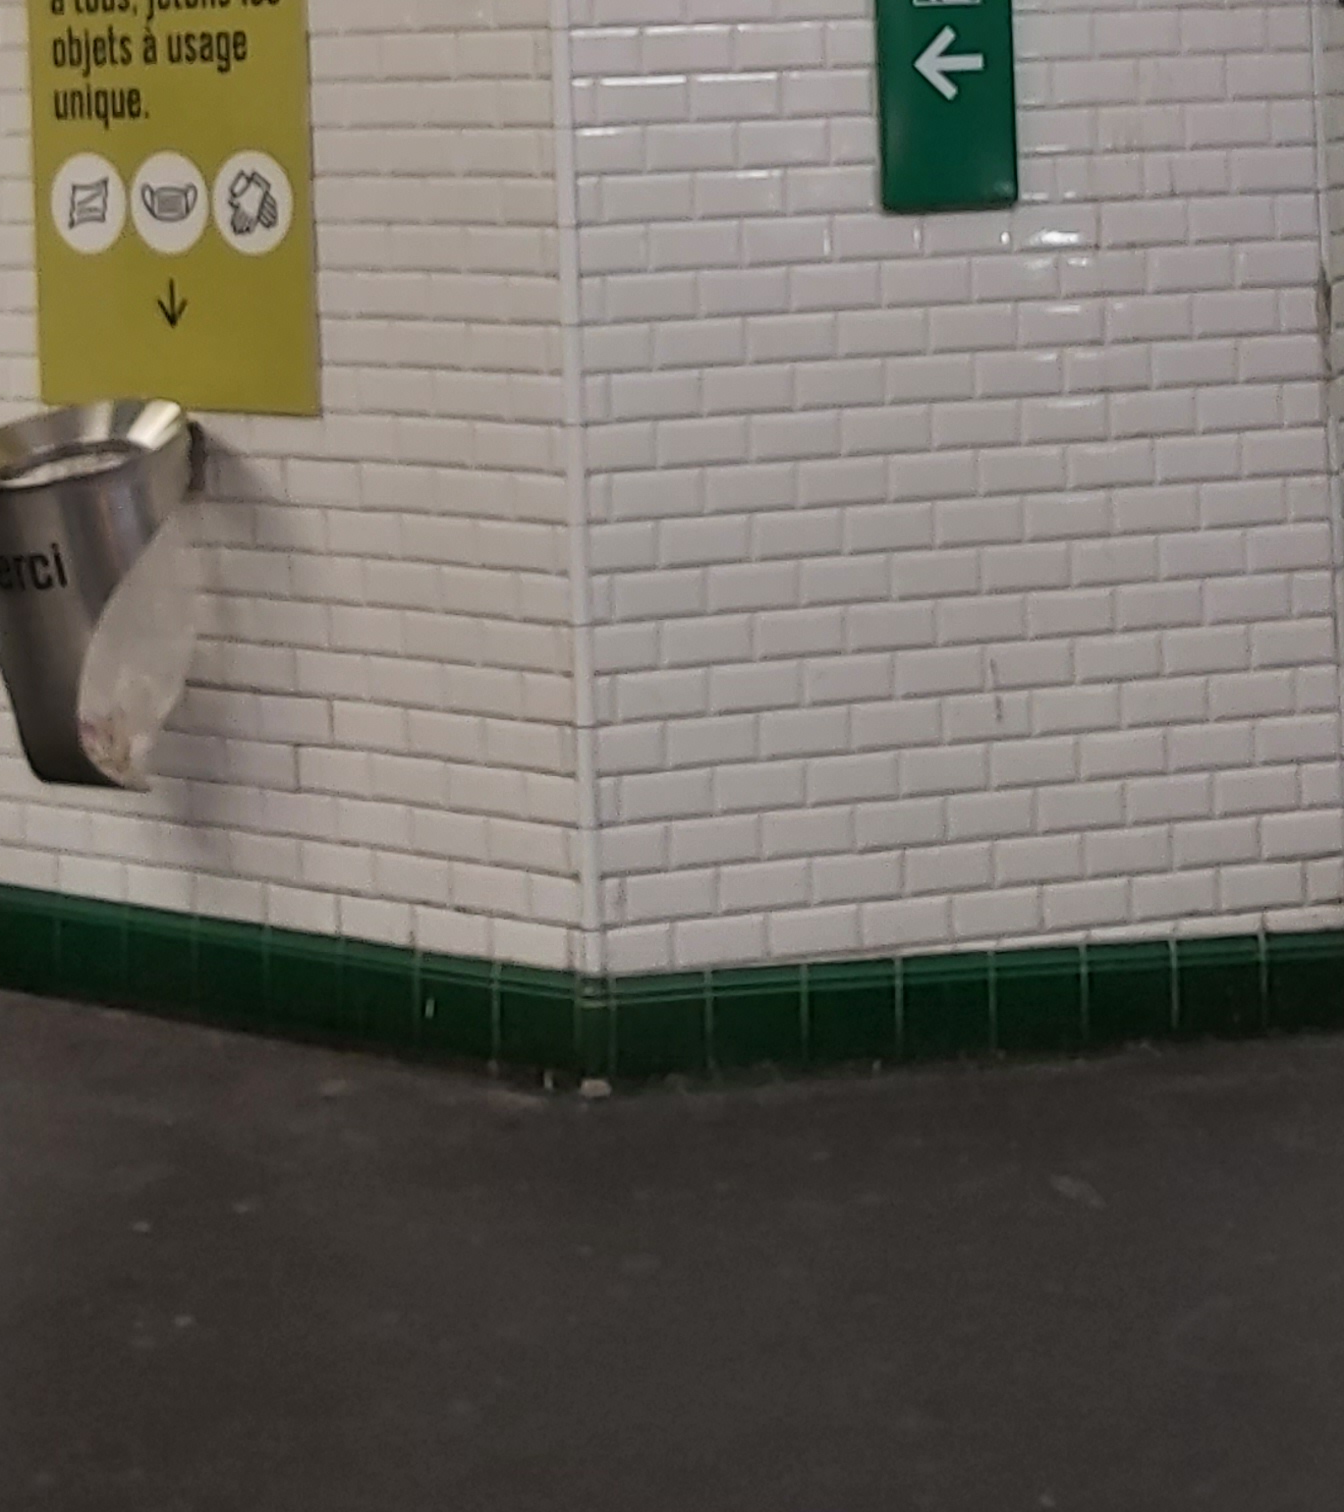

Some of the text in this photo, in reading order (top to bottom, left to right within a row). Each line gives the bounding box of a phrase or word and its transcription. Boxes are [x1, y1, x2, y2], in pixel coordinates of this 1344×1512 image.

[52, 25, 248, 78] objets à usage
[54, 82, 150, 131] unique.
